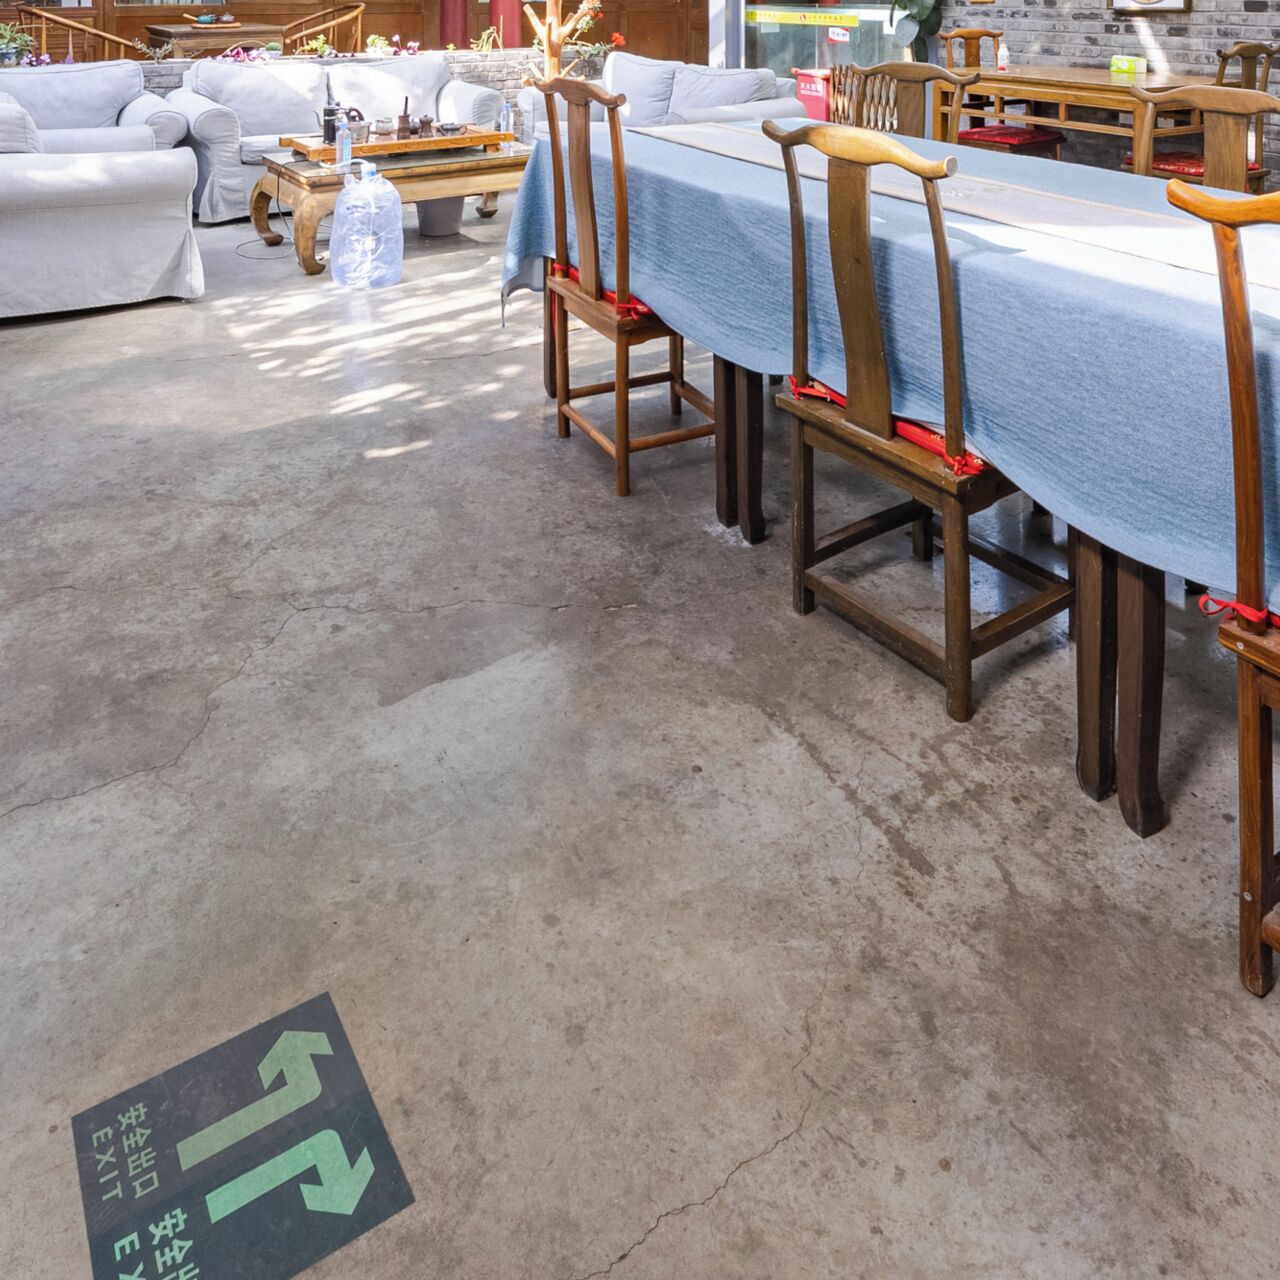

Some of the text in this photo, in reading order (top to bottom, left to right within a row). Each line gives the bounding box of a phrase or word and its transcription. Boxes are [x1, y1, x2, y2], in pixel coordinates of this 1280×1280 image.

[92, 1126, 123, 1200] EXIT
[117, 1102, 160, 1199] 安全出口
